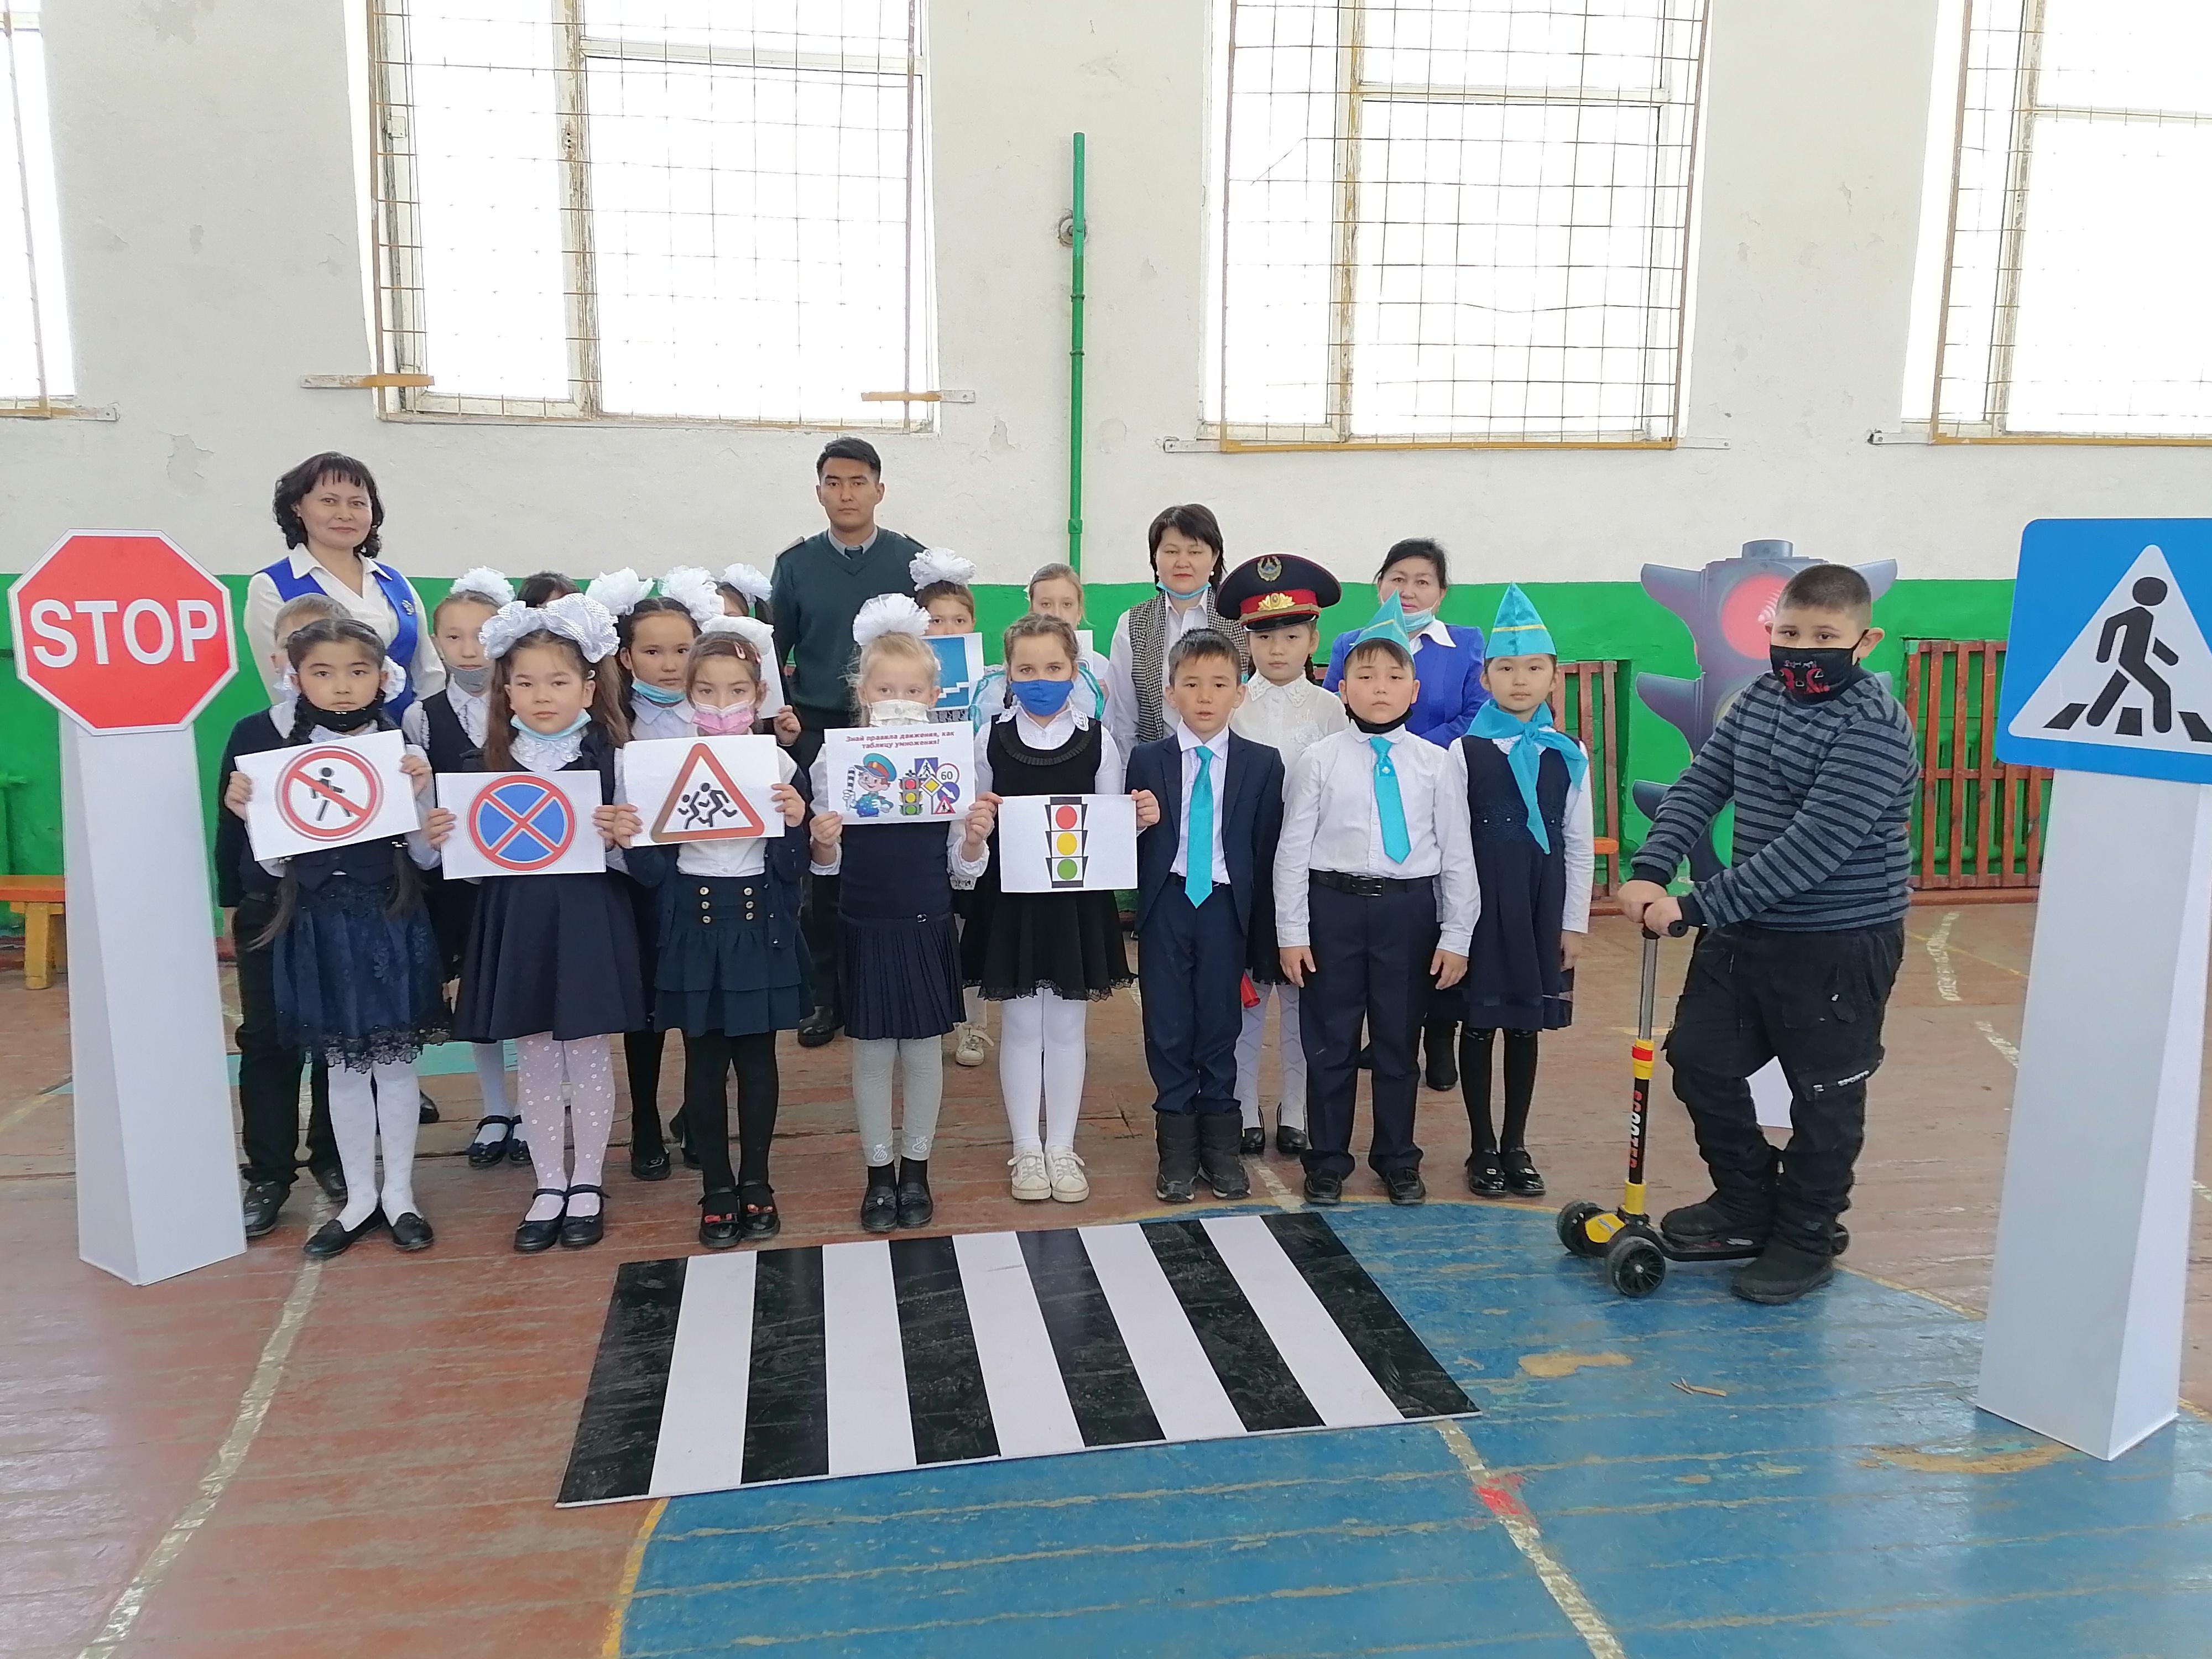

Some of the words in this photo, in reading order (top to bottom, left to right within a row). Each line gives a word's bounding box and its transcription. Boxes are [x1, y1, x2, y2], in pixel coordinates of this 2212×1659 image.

[30, 598, 218, 667] STOP
[895, 738, 940, 748] умножения!
[941, 771, 953, 780] 60
